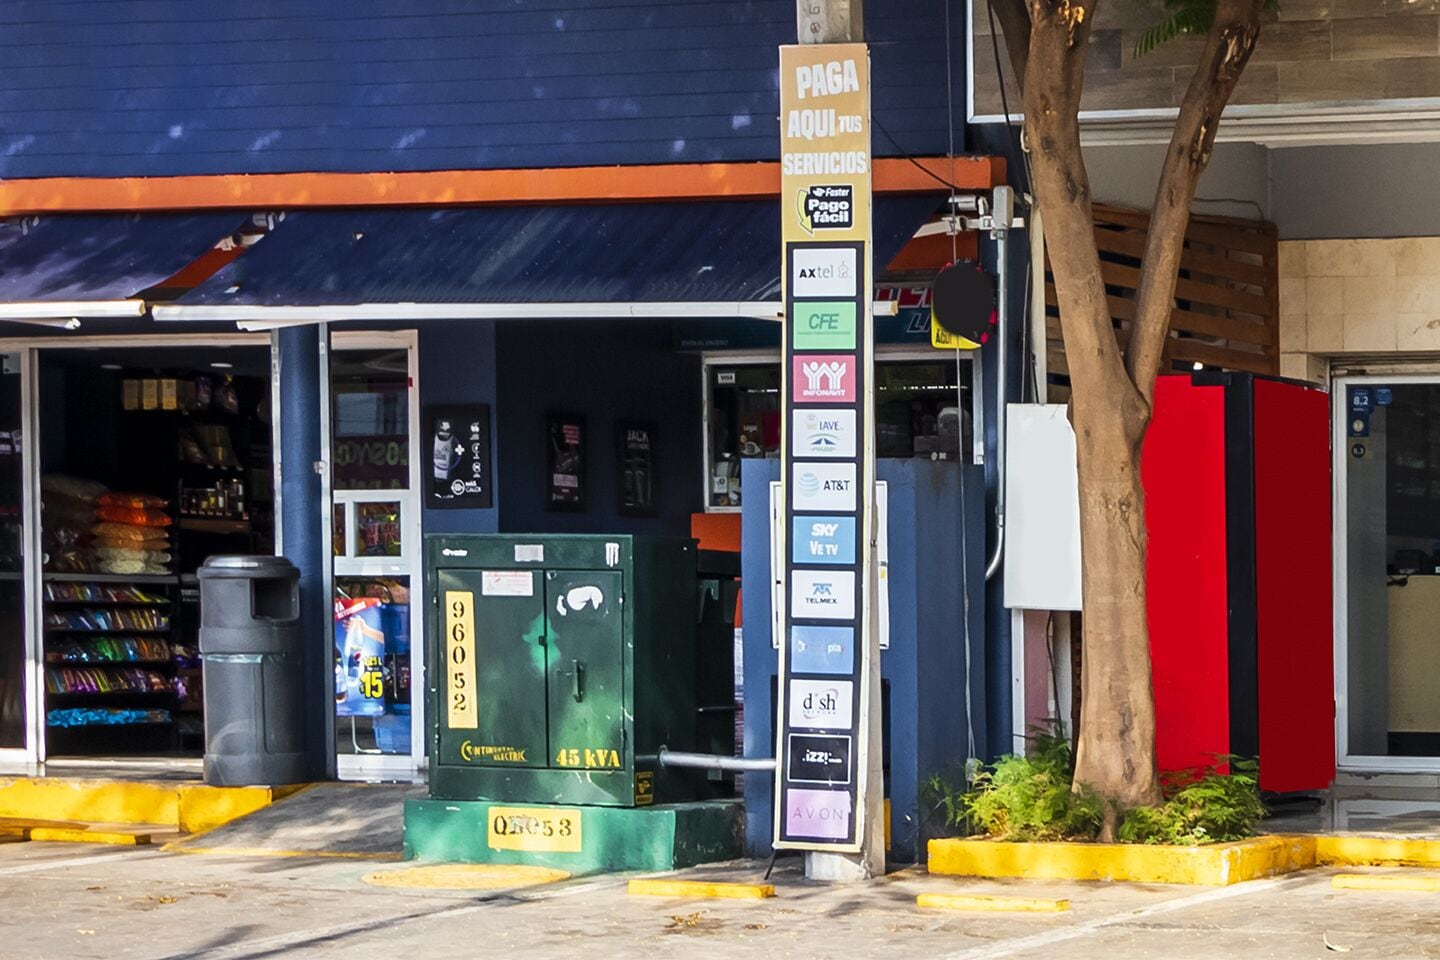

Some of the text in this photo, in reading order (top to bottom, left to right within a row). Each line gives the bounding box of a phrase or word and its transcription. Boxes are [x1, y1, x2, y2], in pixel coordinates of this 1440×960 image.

[796, 59, 859, 99] PAGA
[787, 109, 862, 139] AQUI TUS
[783, 152, 867, 175] SERVICIOS
[808, 198, 849, 213] Pago
[813, 211, 849, 224] fácil
[808, 314, 839, 330] CFE
[1353, 396, 1369, 406] 8.2
[819, 421, 839, 430] IAVE
[823, 480, 850, 491] AT&T
[811, 524, 838, 536] SKY
[826, 544, 838, 555] TV
[452, 601, 466, 711] 96052
[556, 748, 620, 769] 45 kVA
[793, 807, 844, 820] AVON
